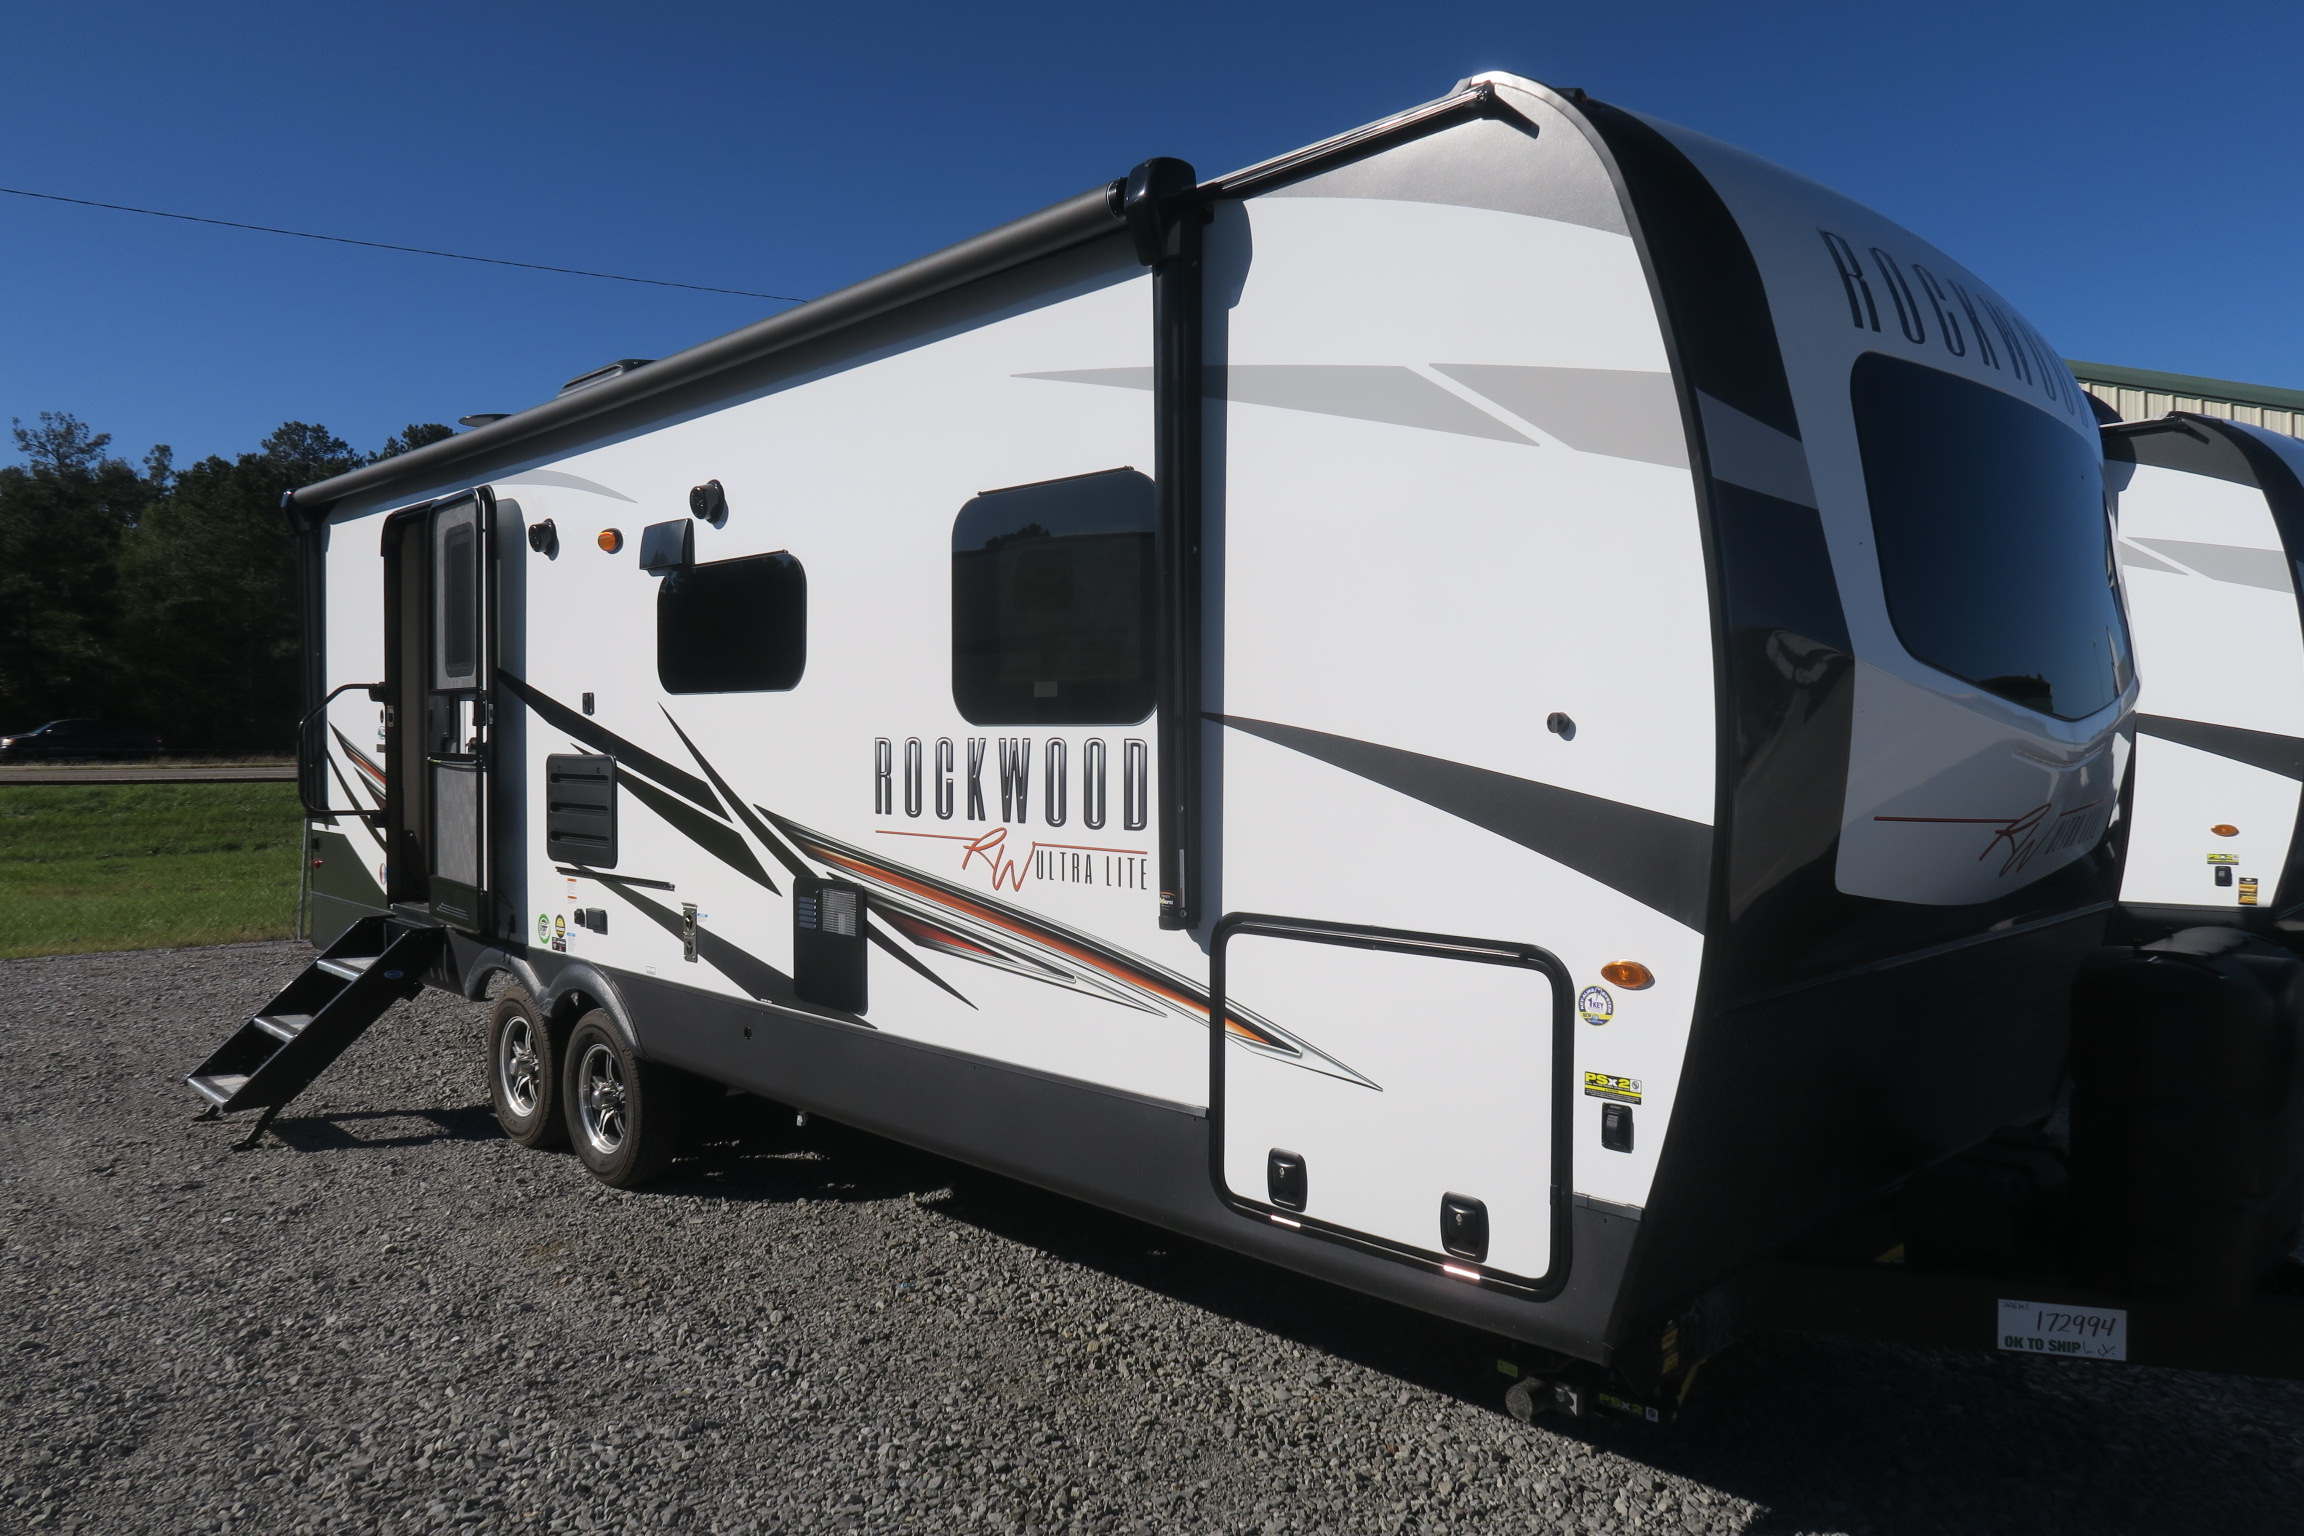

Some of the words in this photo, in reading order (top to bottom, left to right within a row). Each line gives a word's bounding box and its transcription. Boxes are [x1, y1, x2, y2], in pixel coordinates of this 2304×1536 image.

[874, 736, 1148, 831] ROCKWOOD
[1036, 849, 1093, 884] ULTRA
[1106, 856, 1147, 890] LITE
[2037, 1310, 2116, 1337] 172994
[2004, 1335, 2024, 1349] OK
[2026, 1338, 2044, 1350] TO
[2048, 1340, 2081, 1354] SHIP
